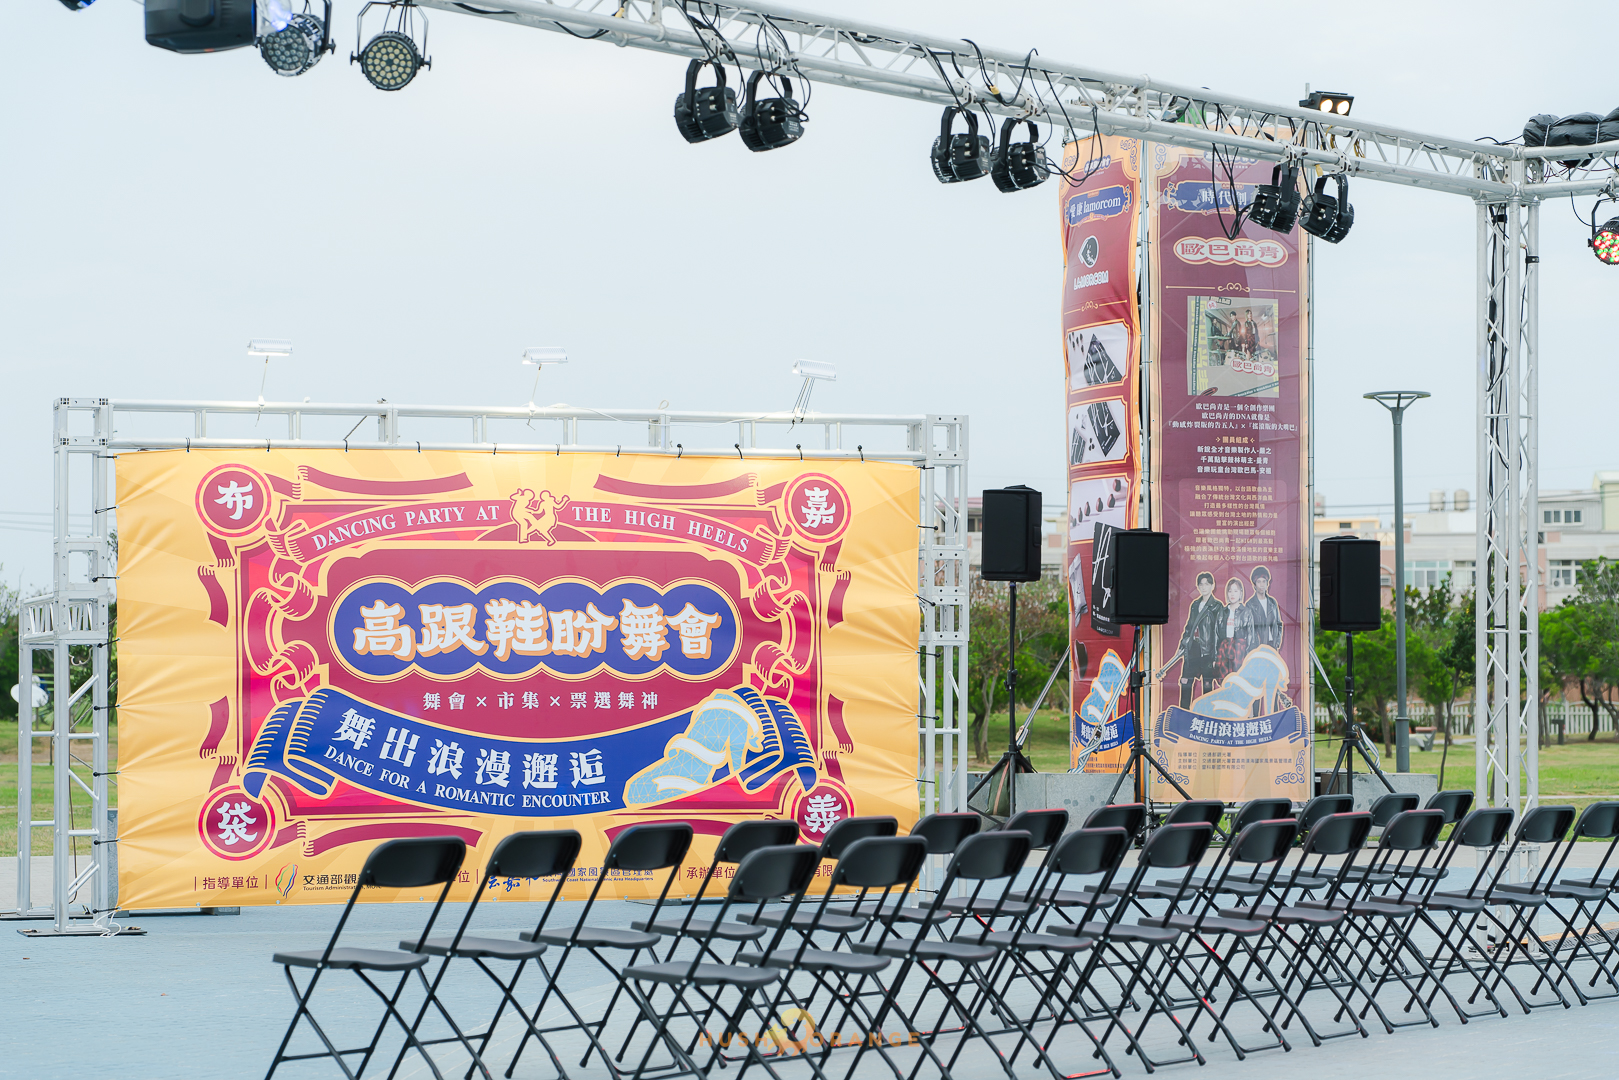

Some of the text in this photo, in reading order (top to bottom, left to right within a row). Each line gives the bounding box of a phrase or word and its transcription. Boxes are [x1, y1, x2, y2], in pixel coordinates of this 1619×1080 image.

[1083, 197, 1121, 213] lamorcom
[1201, 189, 1254, 205] 時代創
[1180, 243, 1279, 259] 歐巴尚青
[1073, 270, 1109, 291] LAMORCOM
[1232, 360, 1273, 374] 歐巴尚青
[1195, 403, 1275, 412] 歐巴尚青是一個全創作樂團
[1201, 412, 1270, 421] 歐巴尚青的DNA就像是
[1222, 436, 1249, 444] 團員組成
[212, 480, 255, 520] 布
[800, 487, 837, 528] 嘉
[311, 505, 500, 550] DANCING PARTY AT
[572, 506, 749, 553] THE HIGH HEELS
[352, 598, 721, 661] 高跟鞋盼舞會
[1189, 716, 1273, 738] 舞出浪漫邂逅
[331, 707, 607, 790] 舞出浪漫邂逅
[1189, 733, 1209, 743] DANCING
[323, 745, 611, 809] DANCE FOR A ROMANTIC ENCOUNTER
[216, 801, 258, 845] 袋
[804, 793, 842, 834] 義
[202, 875, 259, 889] 指導單位
